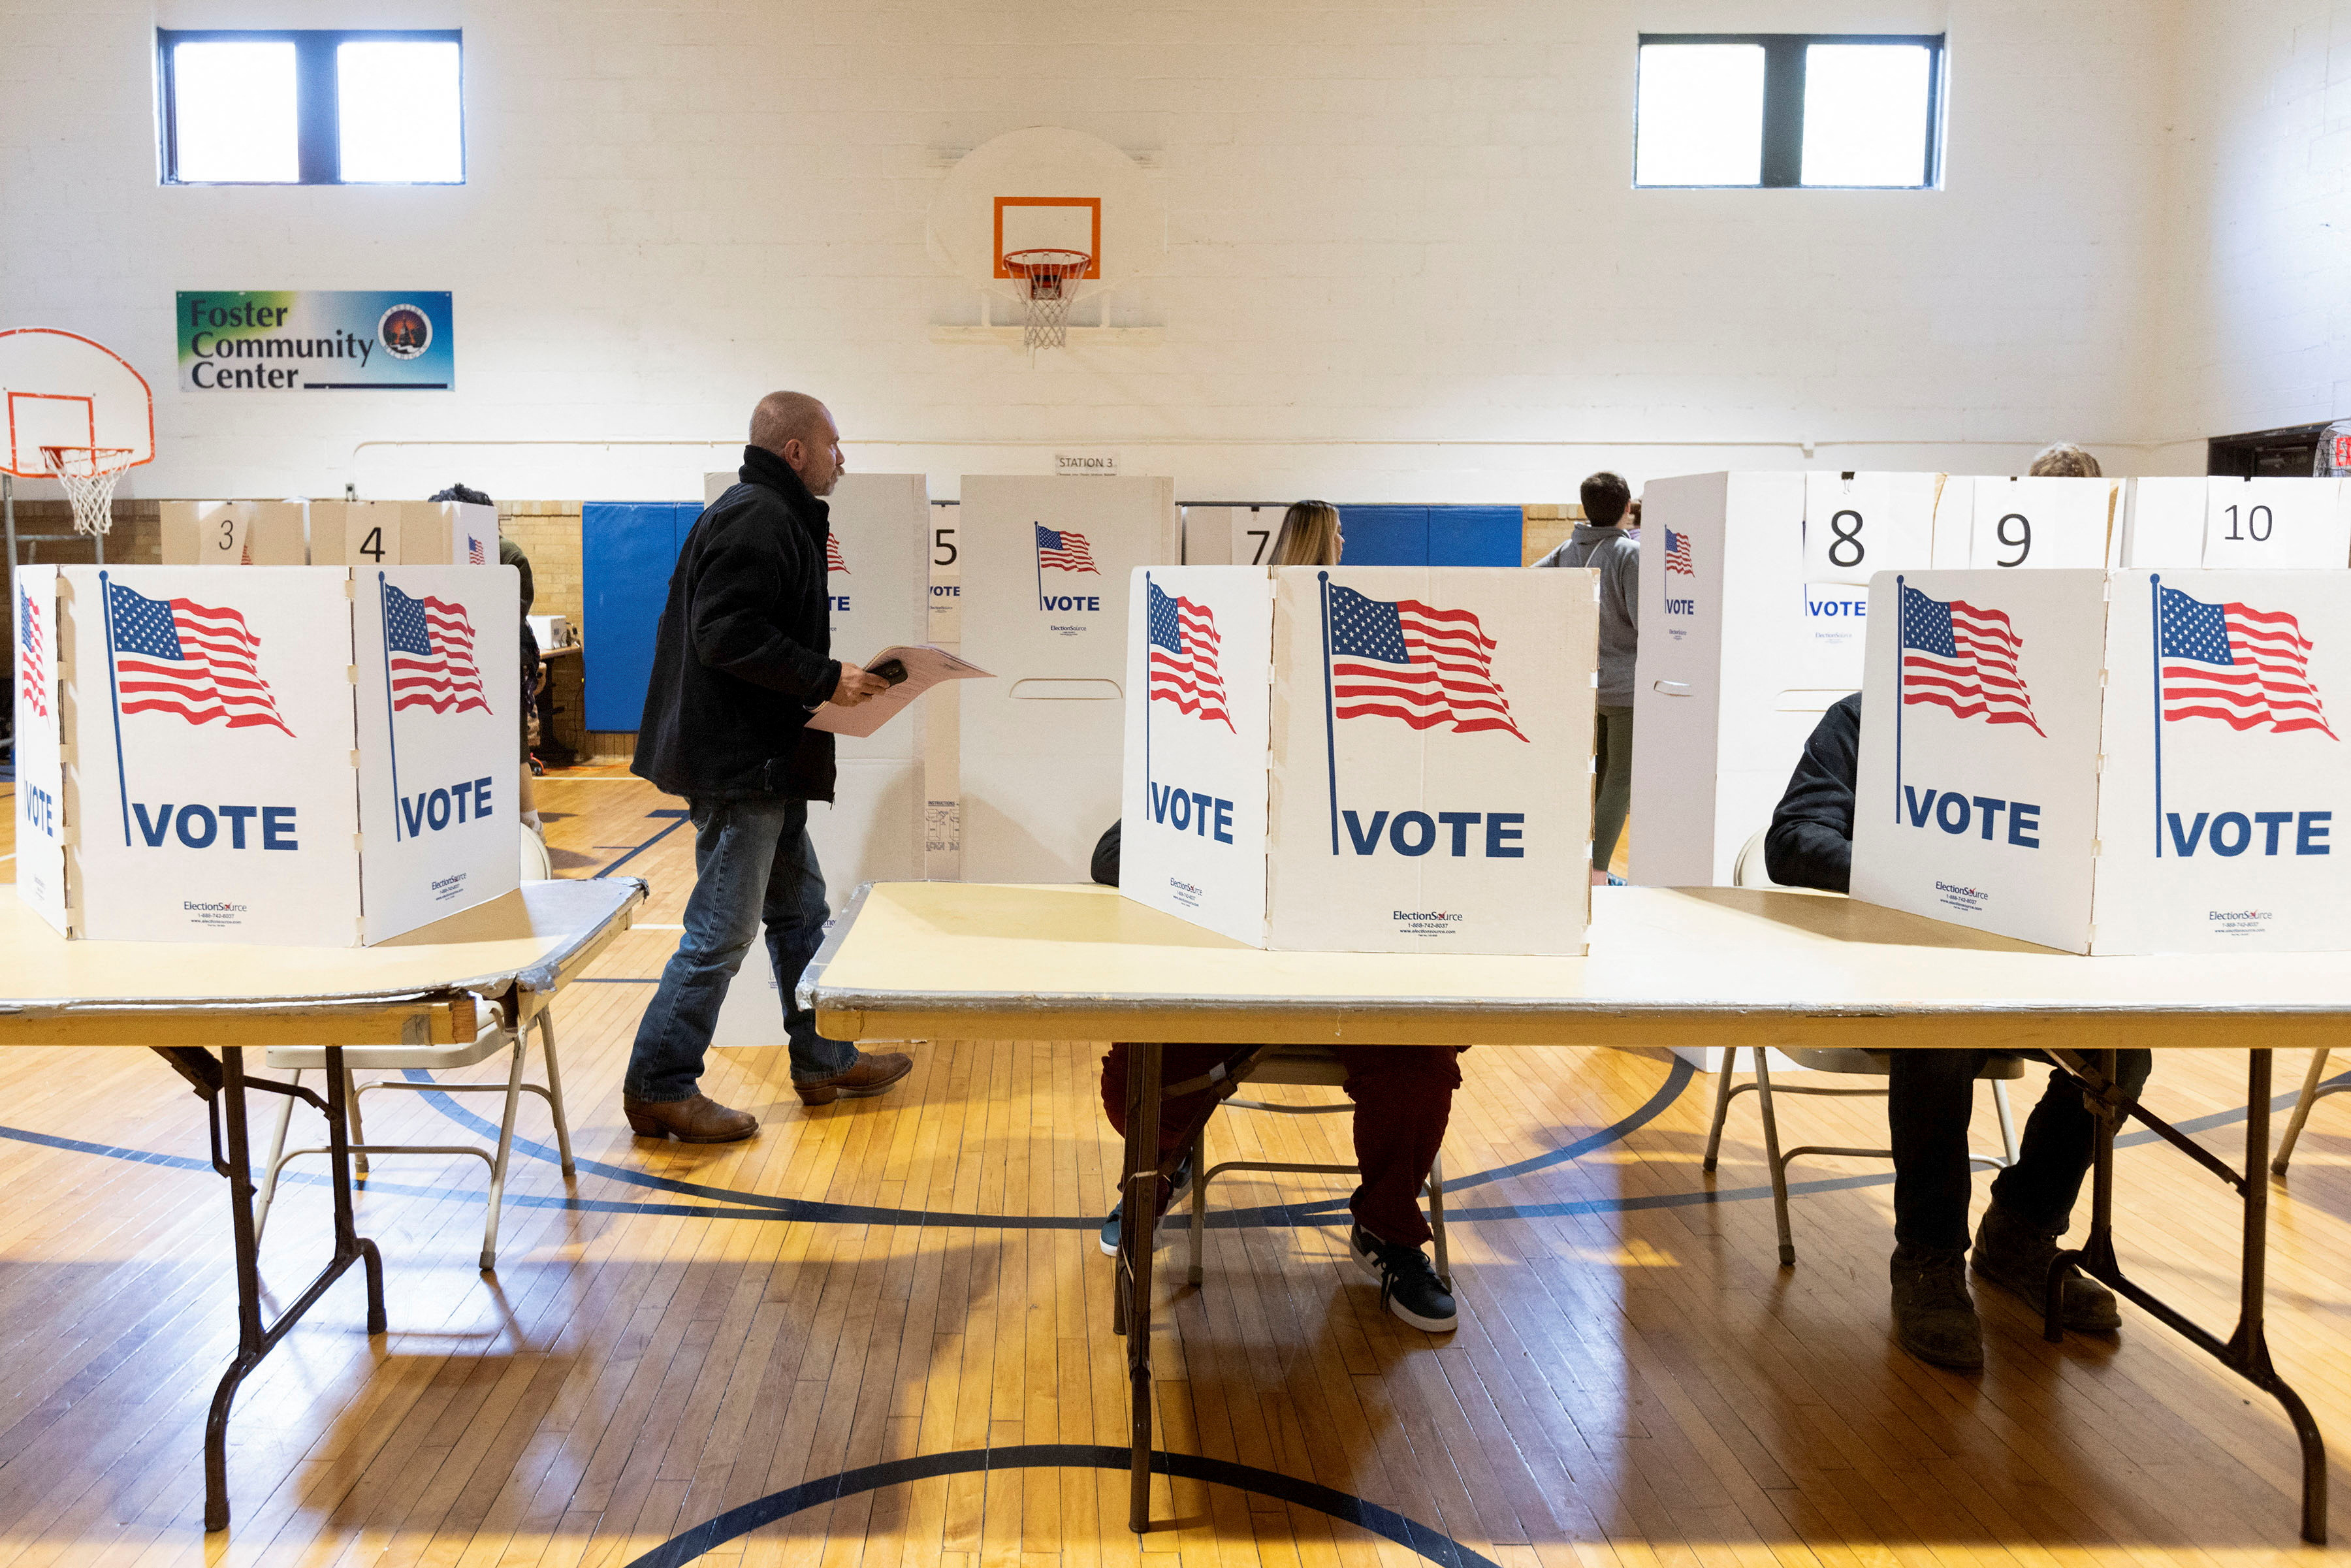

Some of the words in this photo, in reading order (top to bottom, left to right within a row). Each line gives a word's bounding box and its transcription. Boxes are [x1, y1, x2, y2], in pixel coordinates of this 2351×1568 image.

[191, 299, 288, 327] Foster
[191, 329, 374, 368] Community
[191, 361, 299, 389] Center
[1059, 458, 1104, 468] STATION
[1107, 458, 1113, 468] 3
[219, 520, 234, 550] 3
[1829, 509, 1864, 568] 8
[1996, 513, 2031, 568] 9
[2224, 504, 2273, 541] 10
[359, 526, 386, 563] 4
[934, 529, 957, 566] 5
[1247, 530, 1270, 566] 7
[829, 596, 850, 611] TE
[1043, 596, 1100, 611] VOTE
[1666, 599, 1694, 615] VOTE
[1809, 601, 1867, 616] VOTE
[25, 780, 54, 838] VOTE
[400, 776, 493, 839] VOTE
[1151, 781, 1234, 845] VOTE
[1904, 784, 2041, 849] VOTE
[131, 803, 298, 851] VOTE
[1341, 810, 1525, 858] VOTE
[2165, 811, 2332, 857] VOTE
